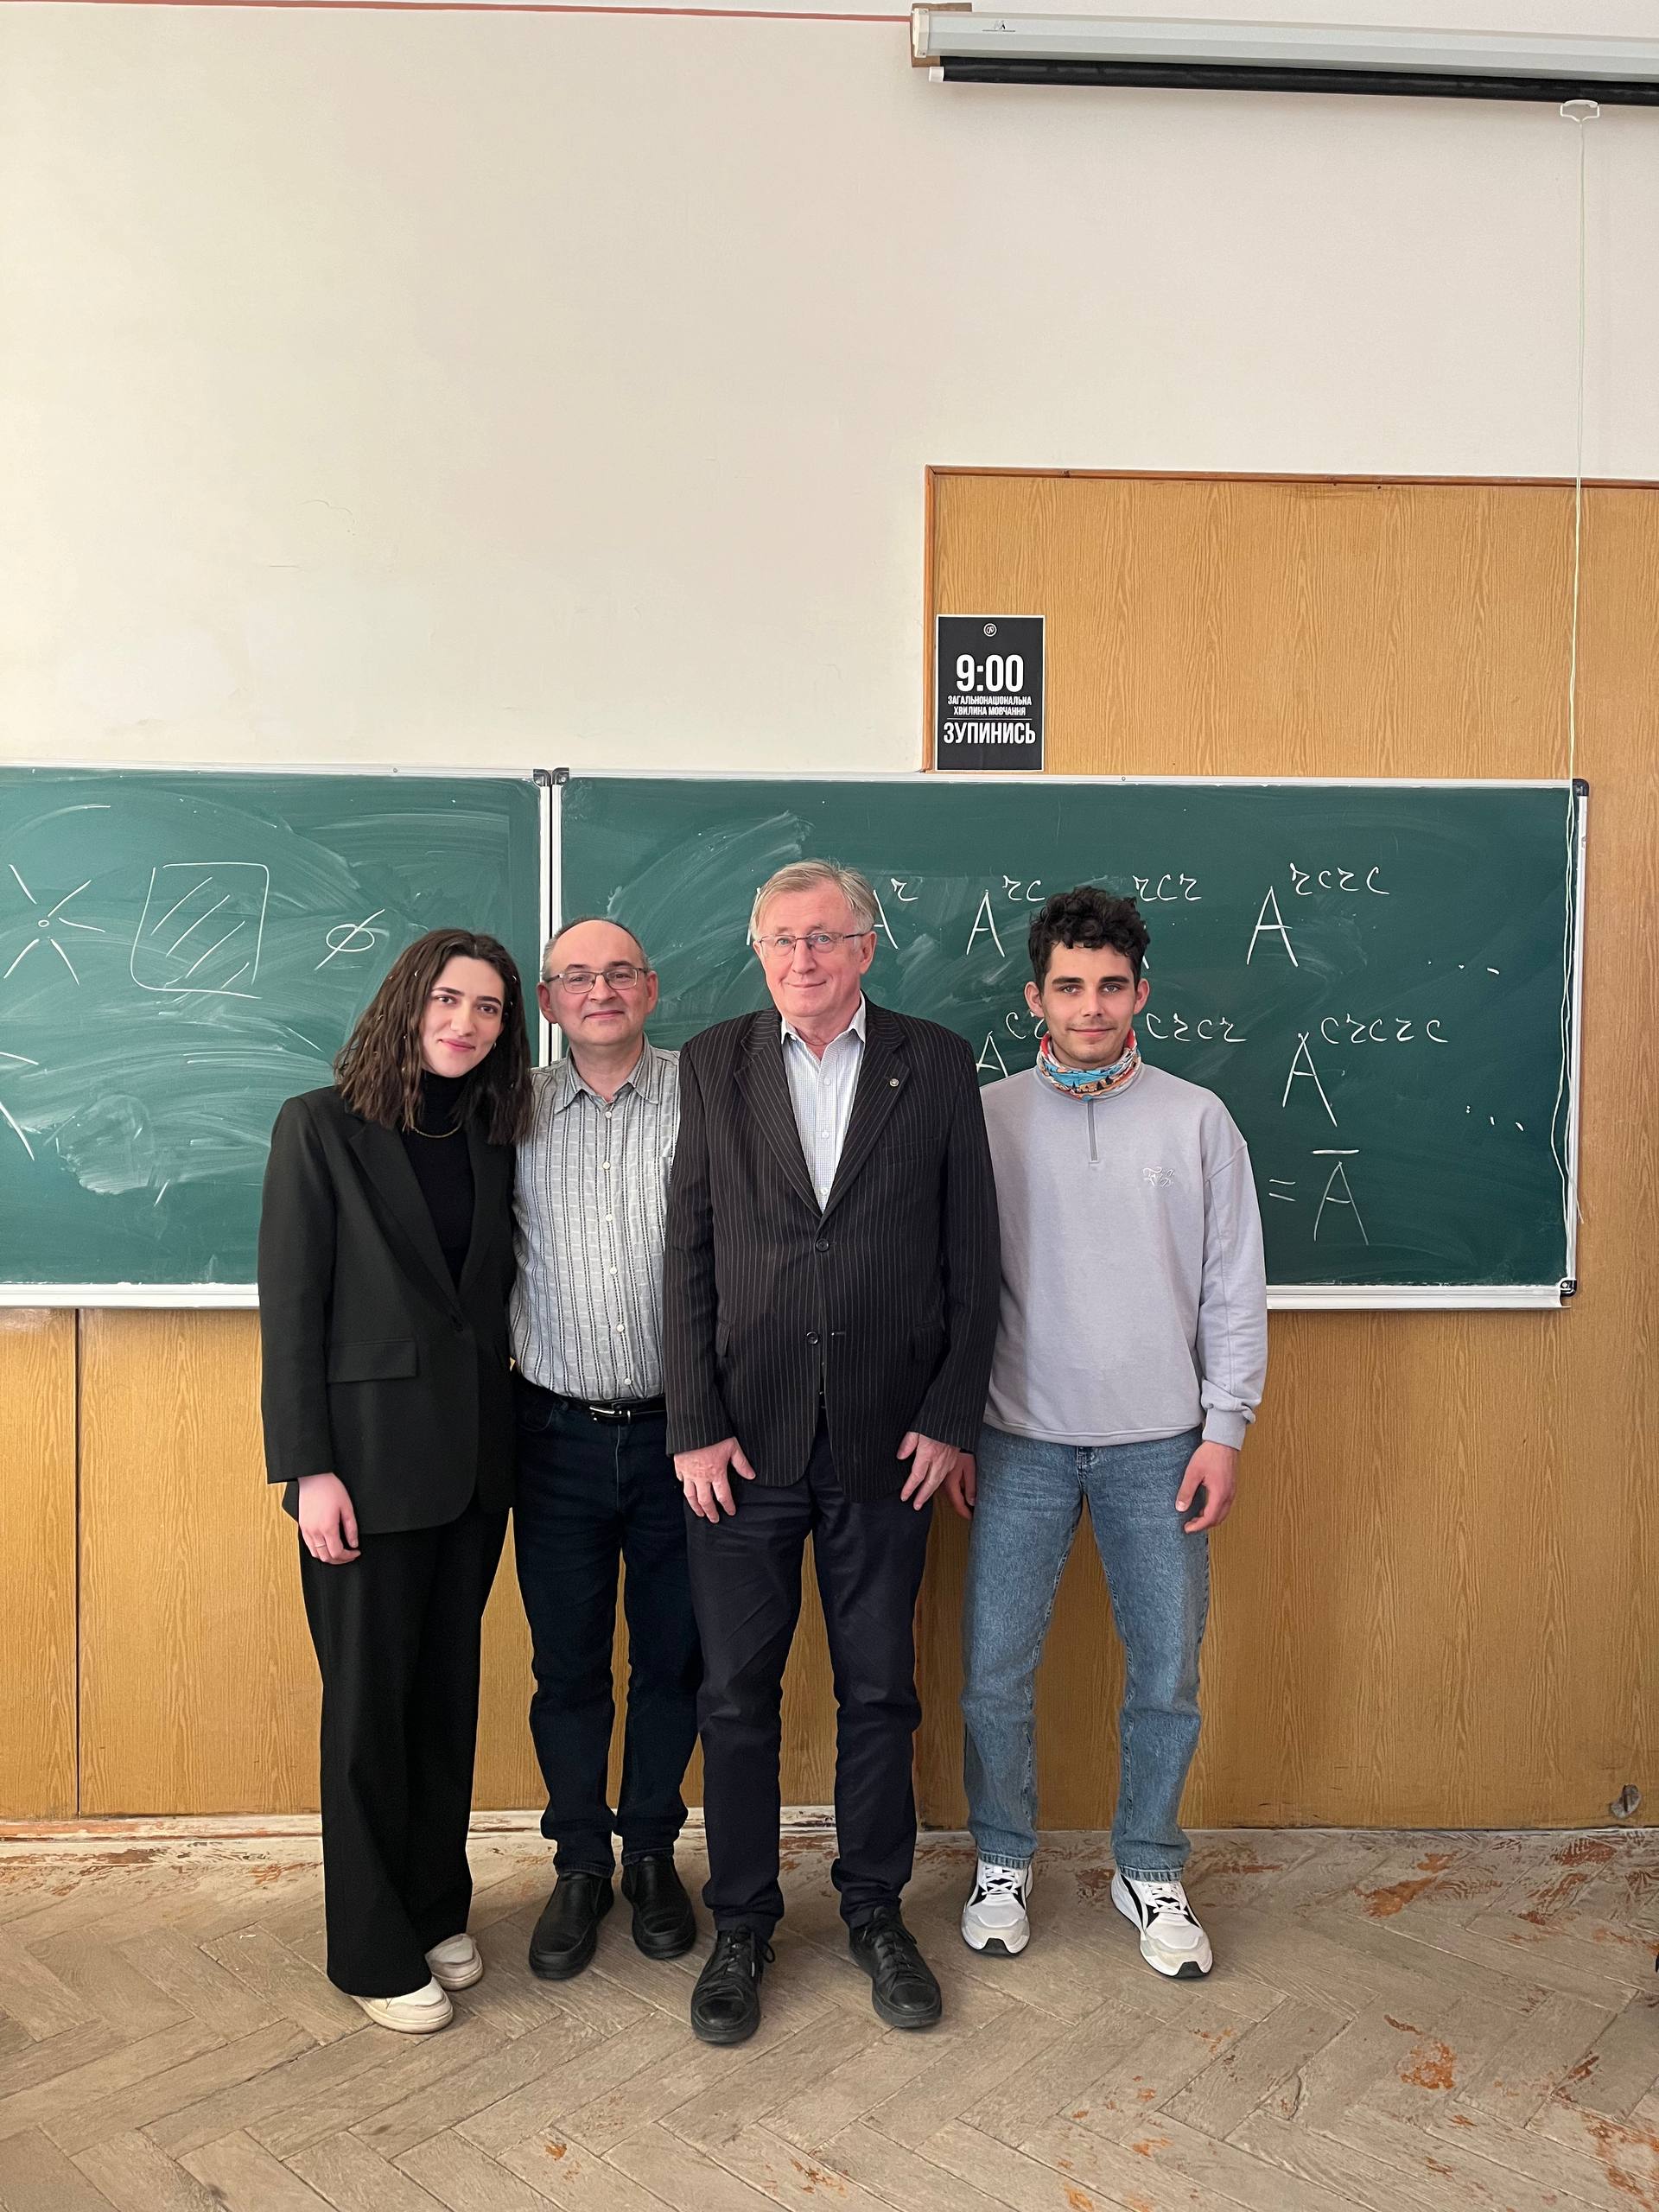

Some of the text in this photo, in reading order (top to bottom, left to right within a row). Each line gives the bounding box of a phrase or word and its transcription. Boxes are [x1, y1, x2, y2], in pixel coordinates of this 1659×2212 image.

[956, 654, 1024, 692] 9:00
[953, 706, 1027, 716] ХВИЛИНА МОВЧАННЯ
[943, 721, 1036, 745] ЗУПИНИСЬ
